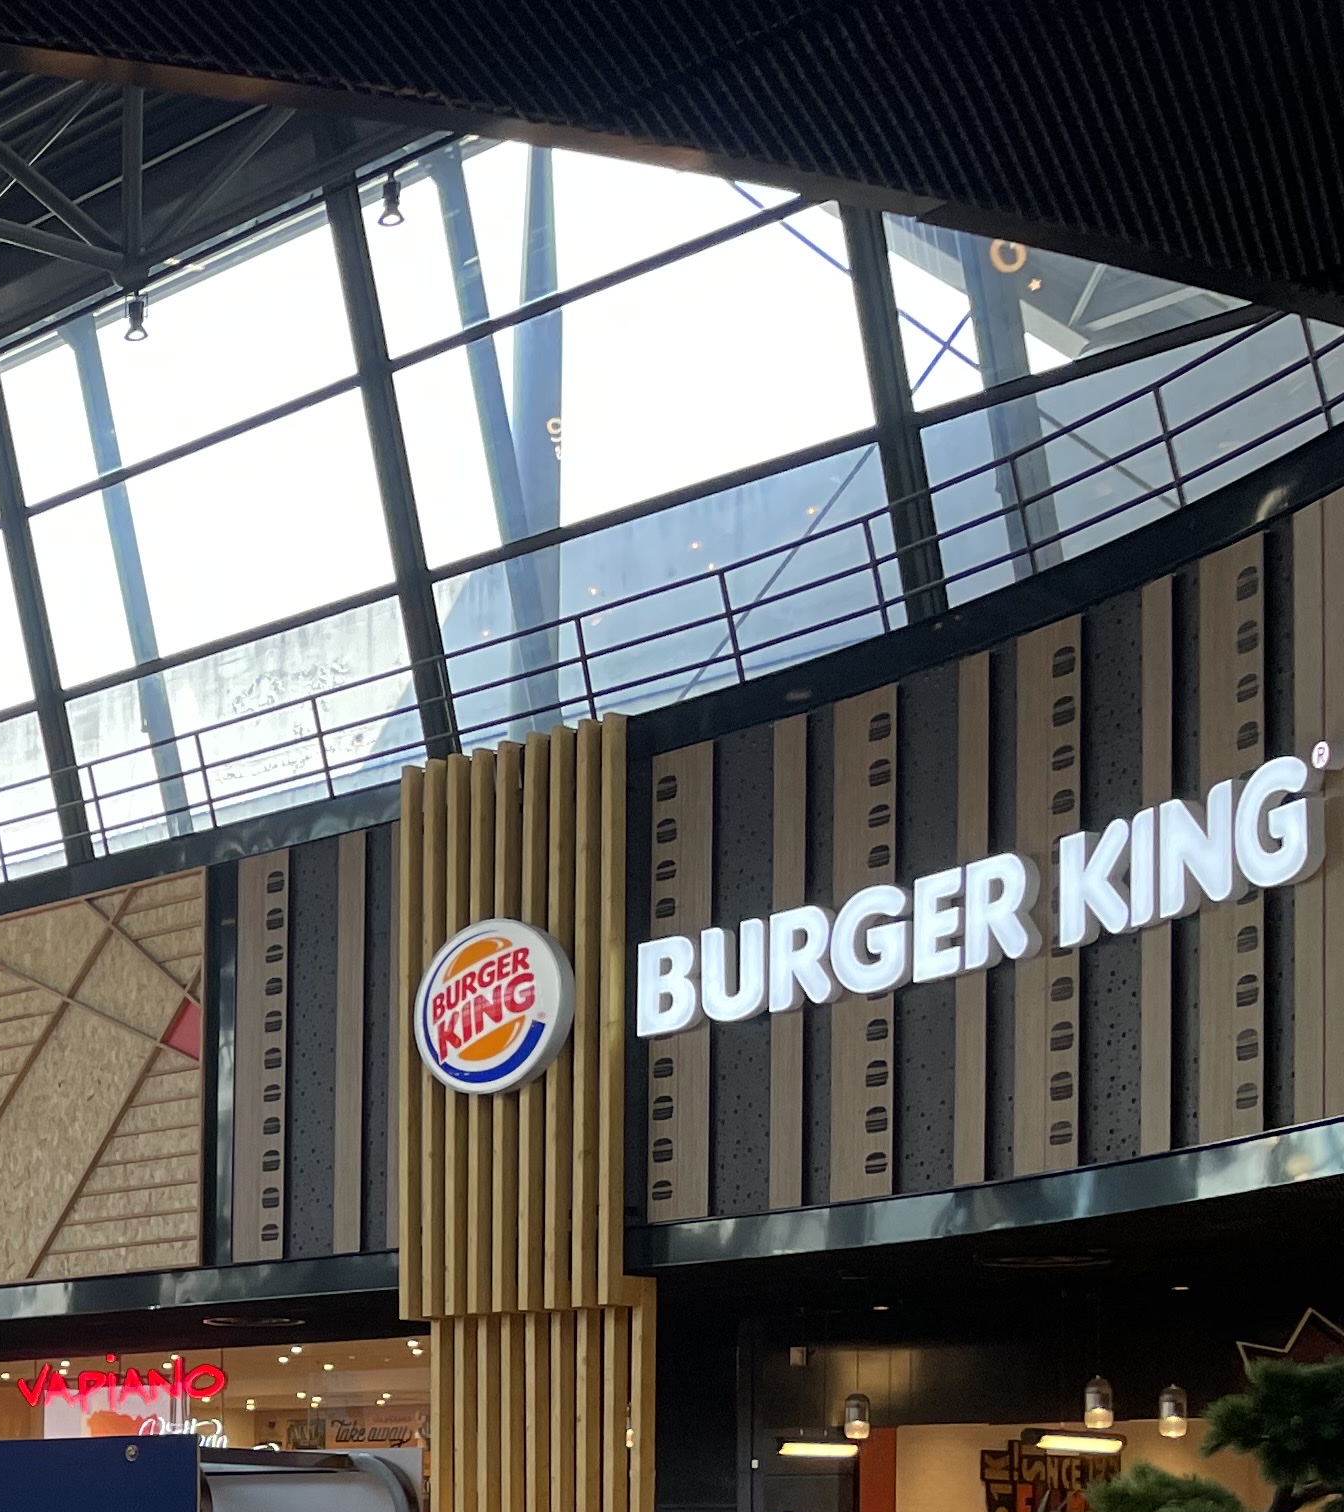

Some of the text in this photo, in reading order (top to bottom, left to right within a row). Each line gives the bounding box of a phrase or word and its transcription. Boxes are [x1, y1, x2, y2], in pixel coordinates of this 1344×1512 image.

[432, 947, 531, 1025] BURGER
[637, 852, 1036, 1037] BURGER
[437, 973, 536, 1063] KING
[18, 1353, 226, 1415] VAPIANO
